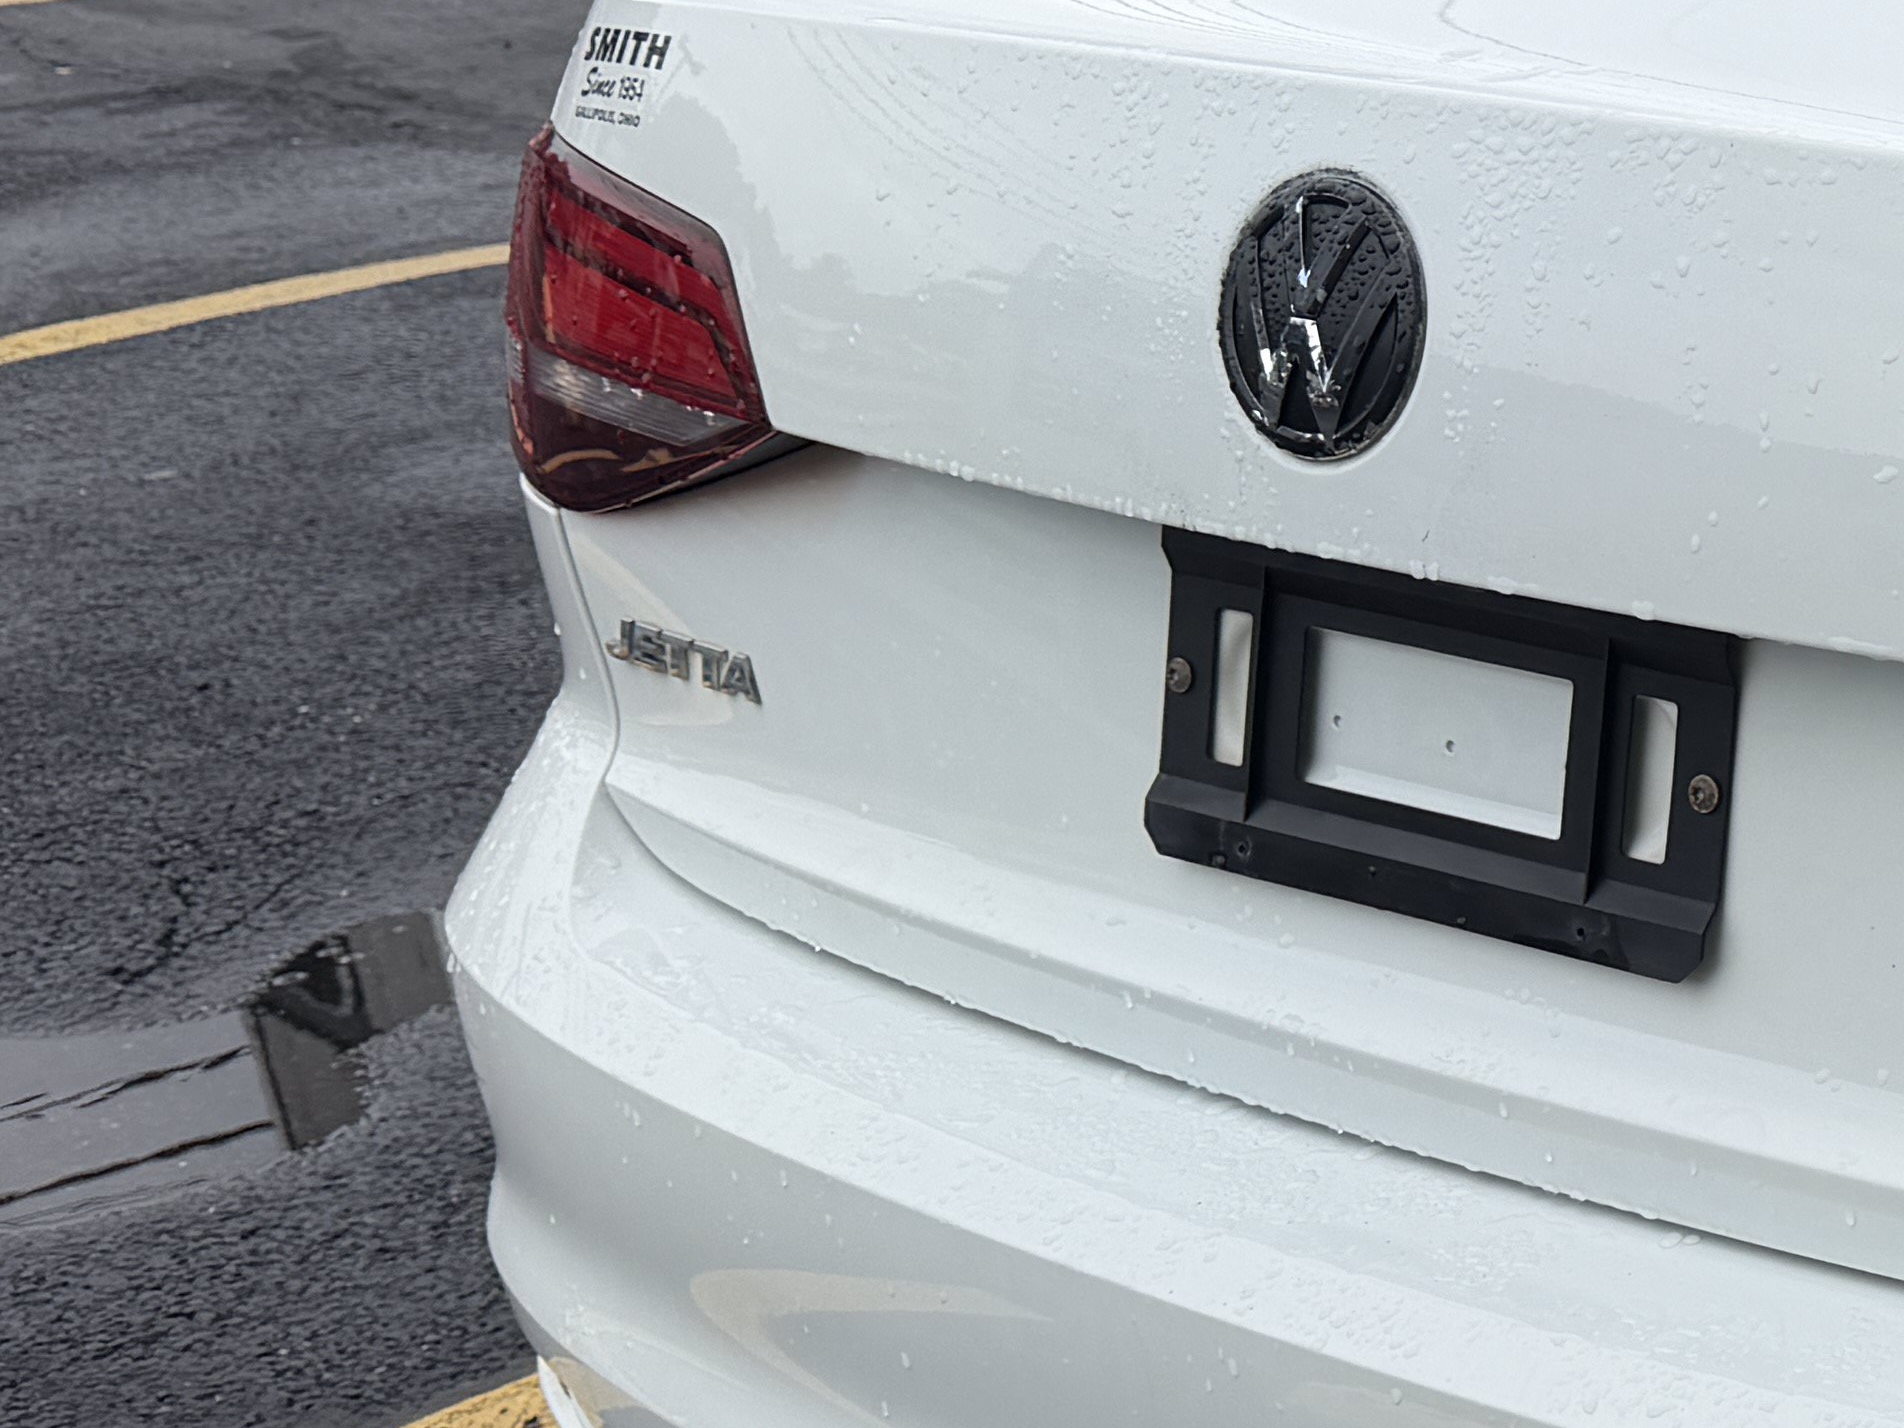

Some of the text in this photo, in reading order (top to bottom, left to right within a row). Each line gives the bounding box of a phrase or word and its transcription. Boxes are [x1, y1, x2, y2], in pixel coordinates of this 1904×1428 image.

[583, 26, 672, 70] SMITH
[580, 66, 645, 102] Since 1954
[605, 617, 763, 707] JETTA
